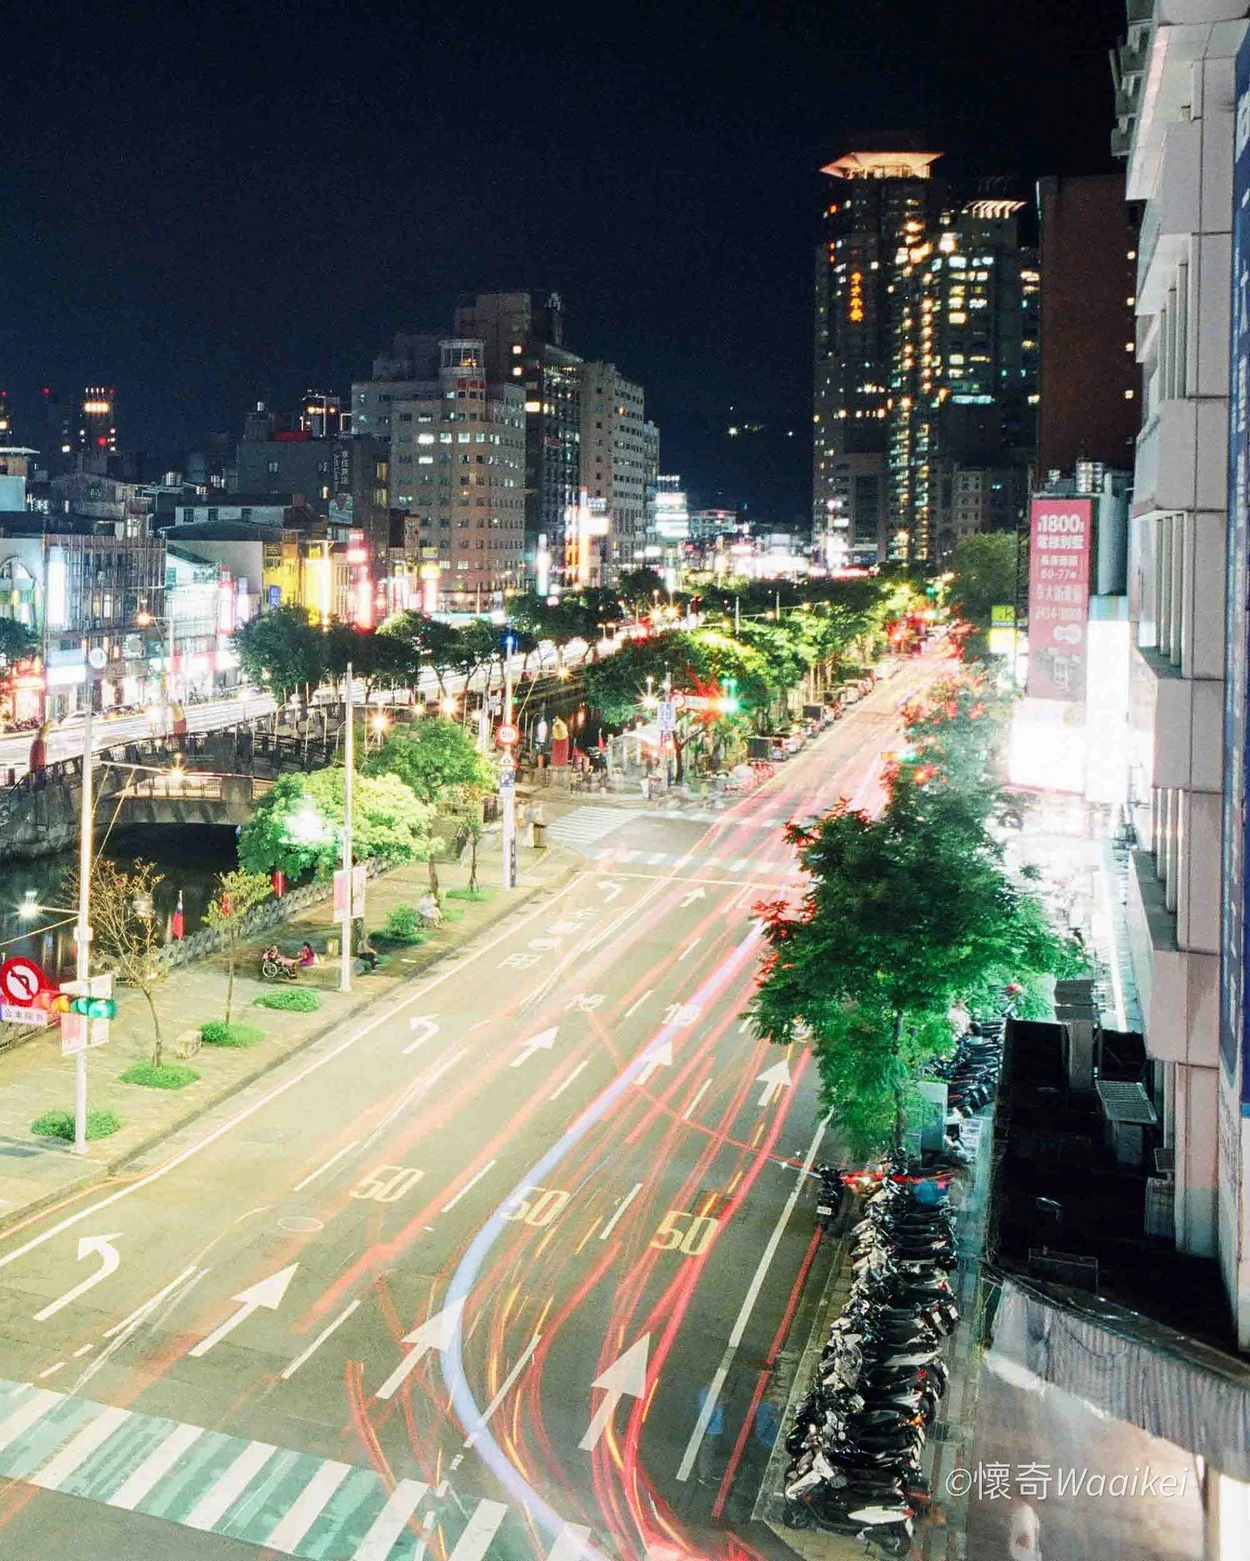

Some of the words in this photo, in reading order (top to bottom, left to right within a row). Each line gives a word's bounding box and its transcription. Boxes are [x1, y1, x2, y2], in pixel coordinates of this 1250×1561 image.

[349, 1165, 426, 1202] 50
[501, 1187, 571, 1227] 50
[650, 1211, 719, 1256] 50
